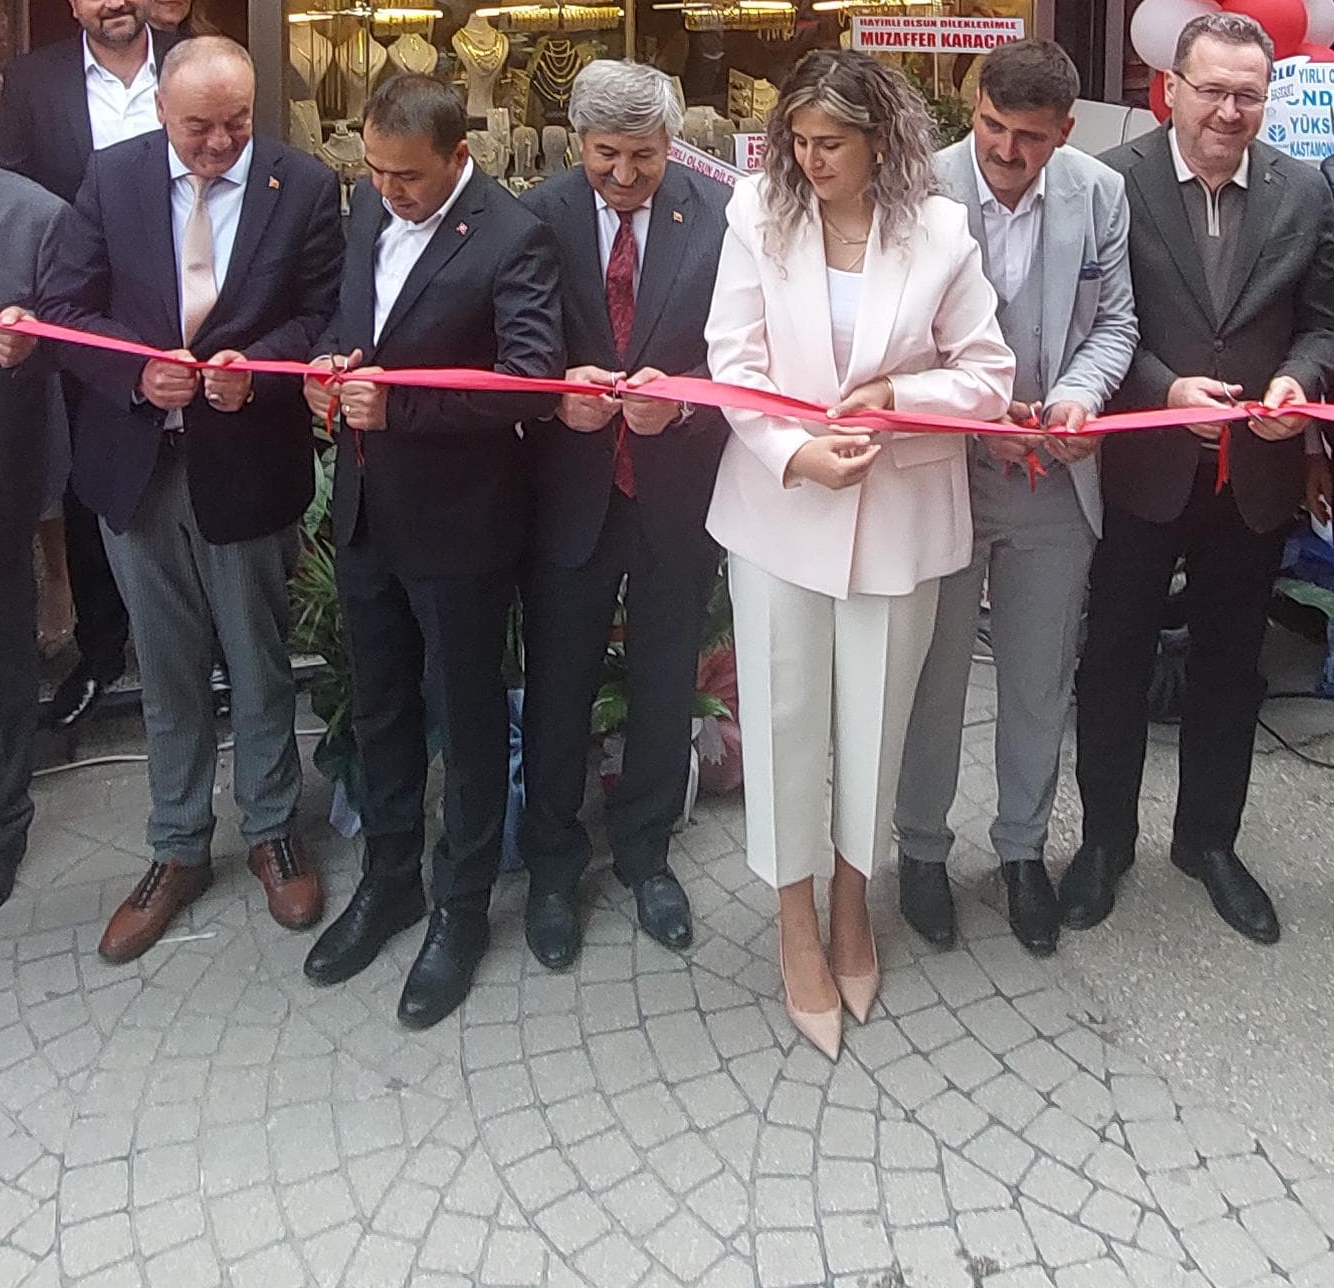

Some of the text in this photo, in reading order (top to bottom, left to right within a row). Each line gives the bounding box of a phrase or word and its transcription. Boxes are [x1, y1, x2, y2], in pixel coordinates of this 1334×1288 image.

[903, 18, 937, 28] OLSUN
[860, 31, 937, 48] MUZAFFER
[687, 155, 713, 175] OLSUN
